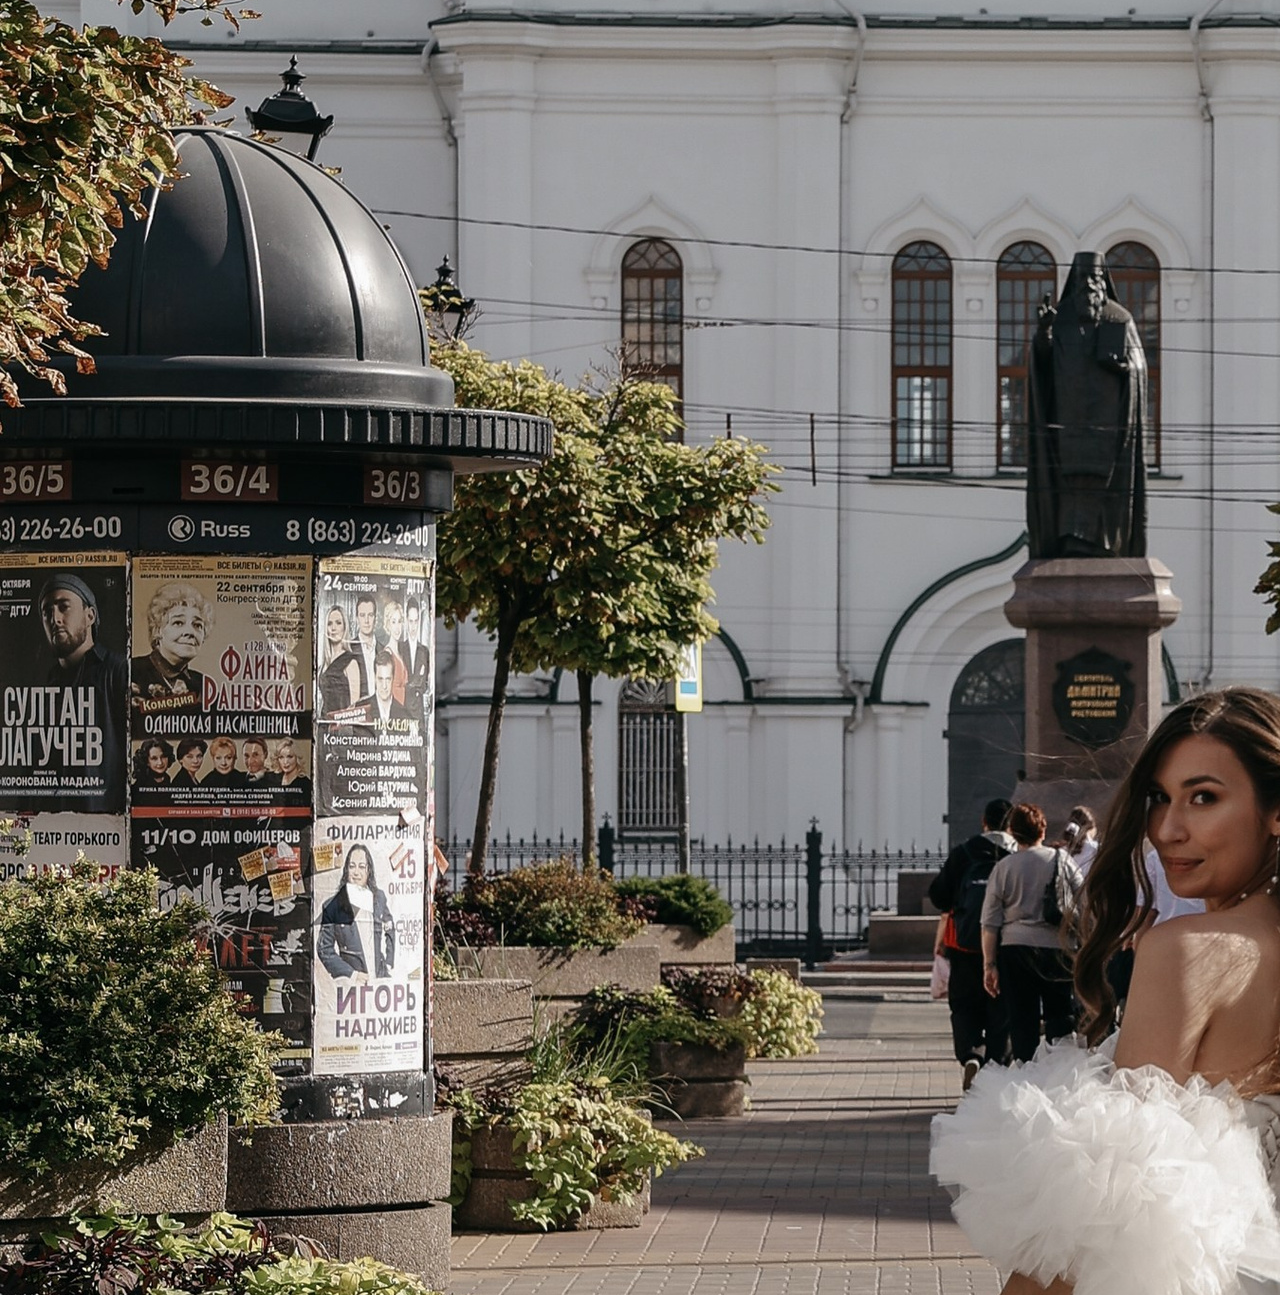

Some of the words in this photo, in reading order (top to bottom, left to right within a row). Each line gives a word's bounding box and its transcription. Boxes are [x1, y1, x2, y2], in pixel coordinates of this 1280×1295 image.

[2, 464, 65, 497] 36/5
[190, 464, 270, 497] 36/4
[371, 469, 420, 502] 36/3
[20, 516, 122, 541] 226-26-00
[201, 520, 250, 537] Russ
[286, 519, 301, 541] 8
[307, 517, 356, 545] (863)
[361, 522, 429, 547] 226-26-00
[217, 561, 229, 570] ВСЕ
[232, 561, 262, 570] БИЛЕТЫ
[274, 562, 307, 571] KASSIR.RU
[2, 579, 32, 588] ОКТЯБРЯ
[216, 581, 231, 593] 22
[233, 581, 285, 597] сентября
[324, 574, 342, 591] 24
[343, 583, 377, 592] СЕНТЯБРЯ
[406, 578, 425, 595] ДГТУ
[217, 593, 281, 605] Конгресс-холл
[10, 604, 32, 618] ДГТУ
[202, 674, 306, 713] РАНЕВСКАЯ
[4, 686, 95, 726] СУЛТАН
[142, 694, 194, 711] Комедия
[144, 714, 212, 735] ОДИНОКАЯ
[215, 715, 299, 736] НАСМЕШНИЦА
[0, 727, 103, 766] ЛАГУЧЕВ
[323, 733, 378, 746] Константин
[346, 750, 381, 763] Марина
[382, 750, 411, 763] ЗУДИНА
[337, 764, 378, 777] Алексей
[378, 766, 416, 778] БАРДУКОВ
[60, 776, 105, 788] МАДАМ»
[348, 780, 376, 793] Юрий
[332, 796, 368, 808] Ксения
[33, 832, 62, 845] ТЕАТР
[64, 832, 120, 846] ГОРЬКОГО
[141, 828, 196, 846] 11/10
[201, 830, 230, 847] ДОМ
[233, 829, 301, 846] ОФИЦЕРОВ
[336, 983, 416, 1015] ИГОРЬ
[335, 1015, 417, 1040] НАДЖИЕВ
